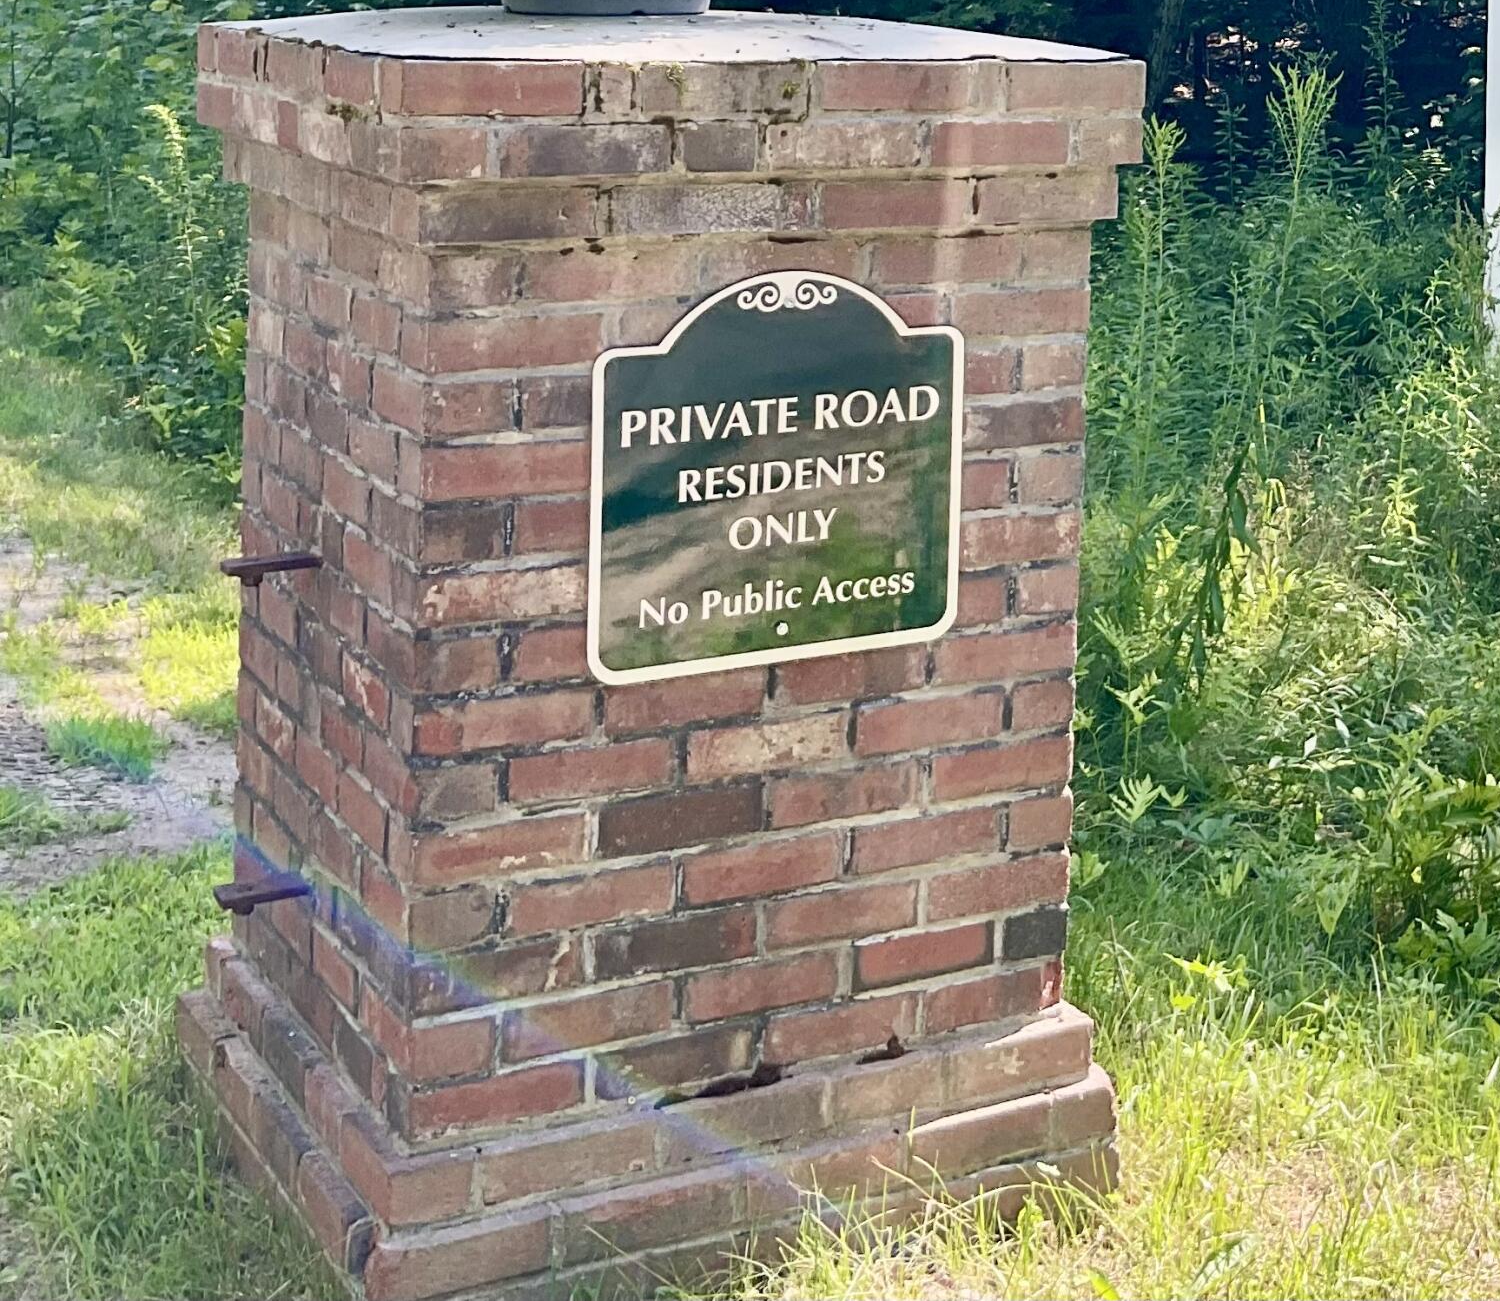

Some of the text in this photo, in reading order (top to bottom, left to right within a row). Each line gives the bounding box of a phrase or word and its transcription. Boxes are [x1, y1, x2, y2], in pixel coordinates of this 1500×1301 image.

[620, 384, 940, 449] PRIVATE ROAD
[678, 450, 886, 503] RESIDENTS
[727, 507, 839, 551] ONLY
[638, 570, 916, 629] No Public Access
